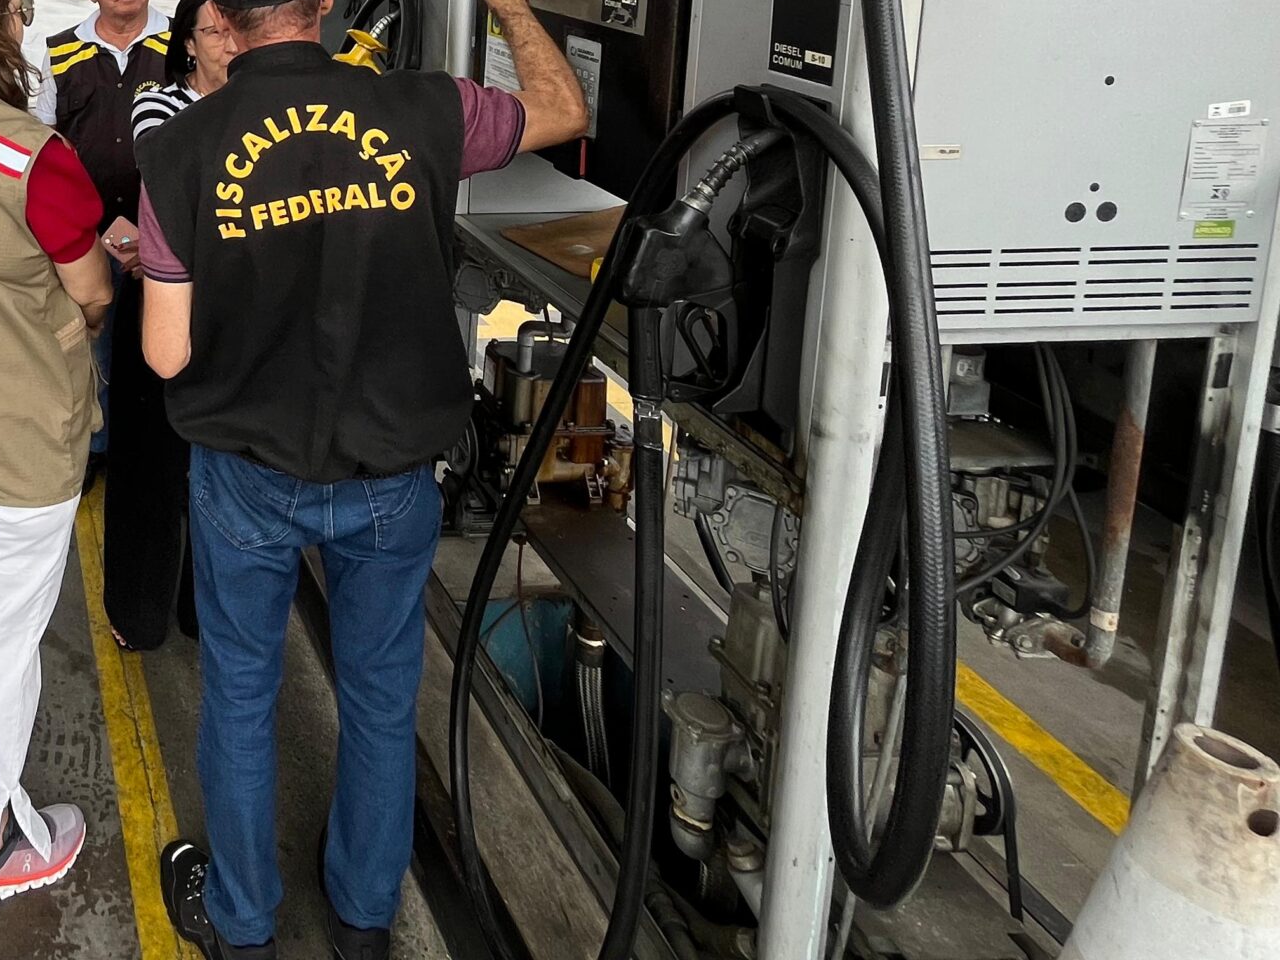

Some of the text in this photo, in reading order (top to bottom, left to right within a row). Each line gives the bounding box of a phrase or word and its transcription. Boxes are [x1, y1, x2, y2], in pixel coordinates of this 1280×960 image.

[772, 53, 827, 70] COMUM S-10
[774, 42, 802, 58] DIESEL
[215, 103, 416, 240] FISCALIZAÇÃO
[250, 182, 387, 231] FEDERAL
